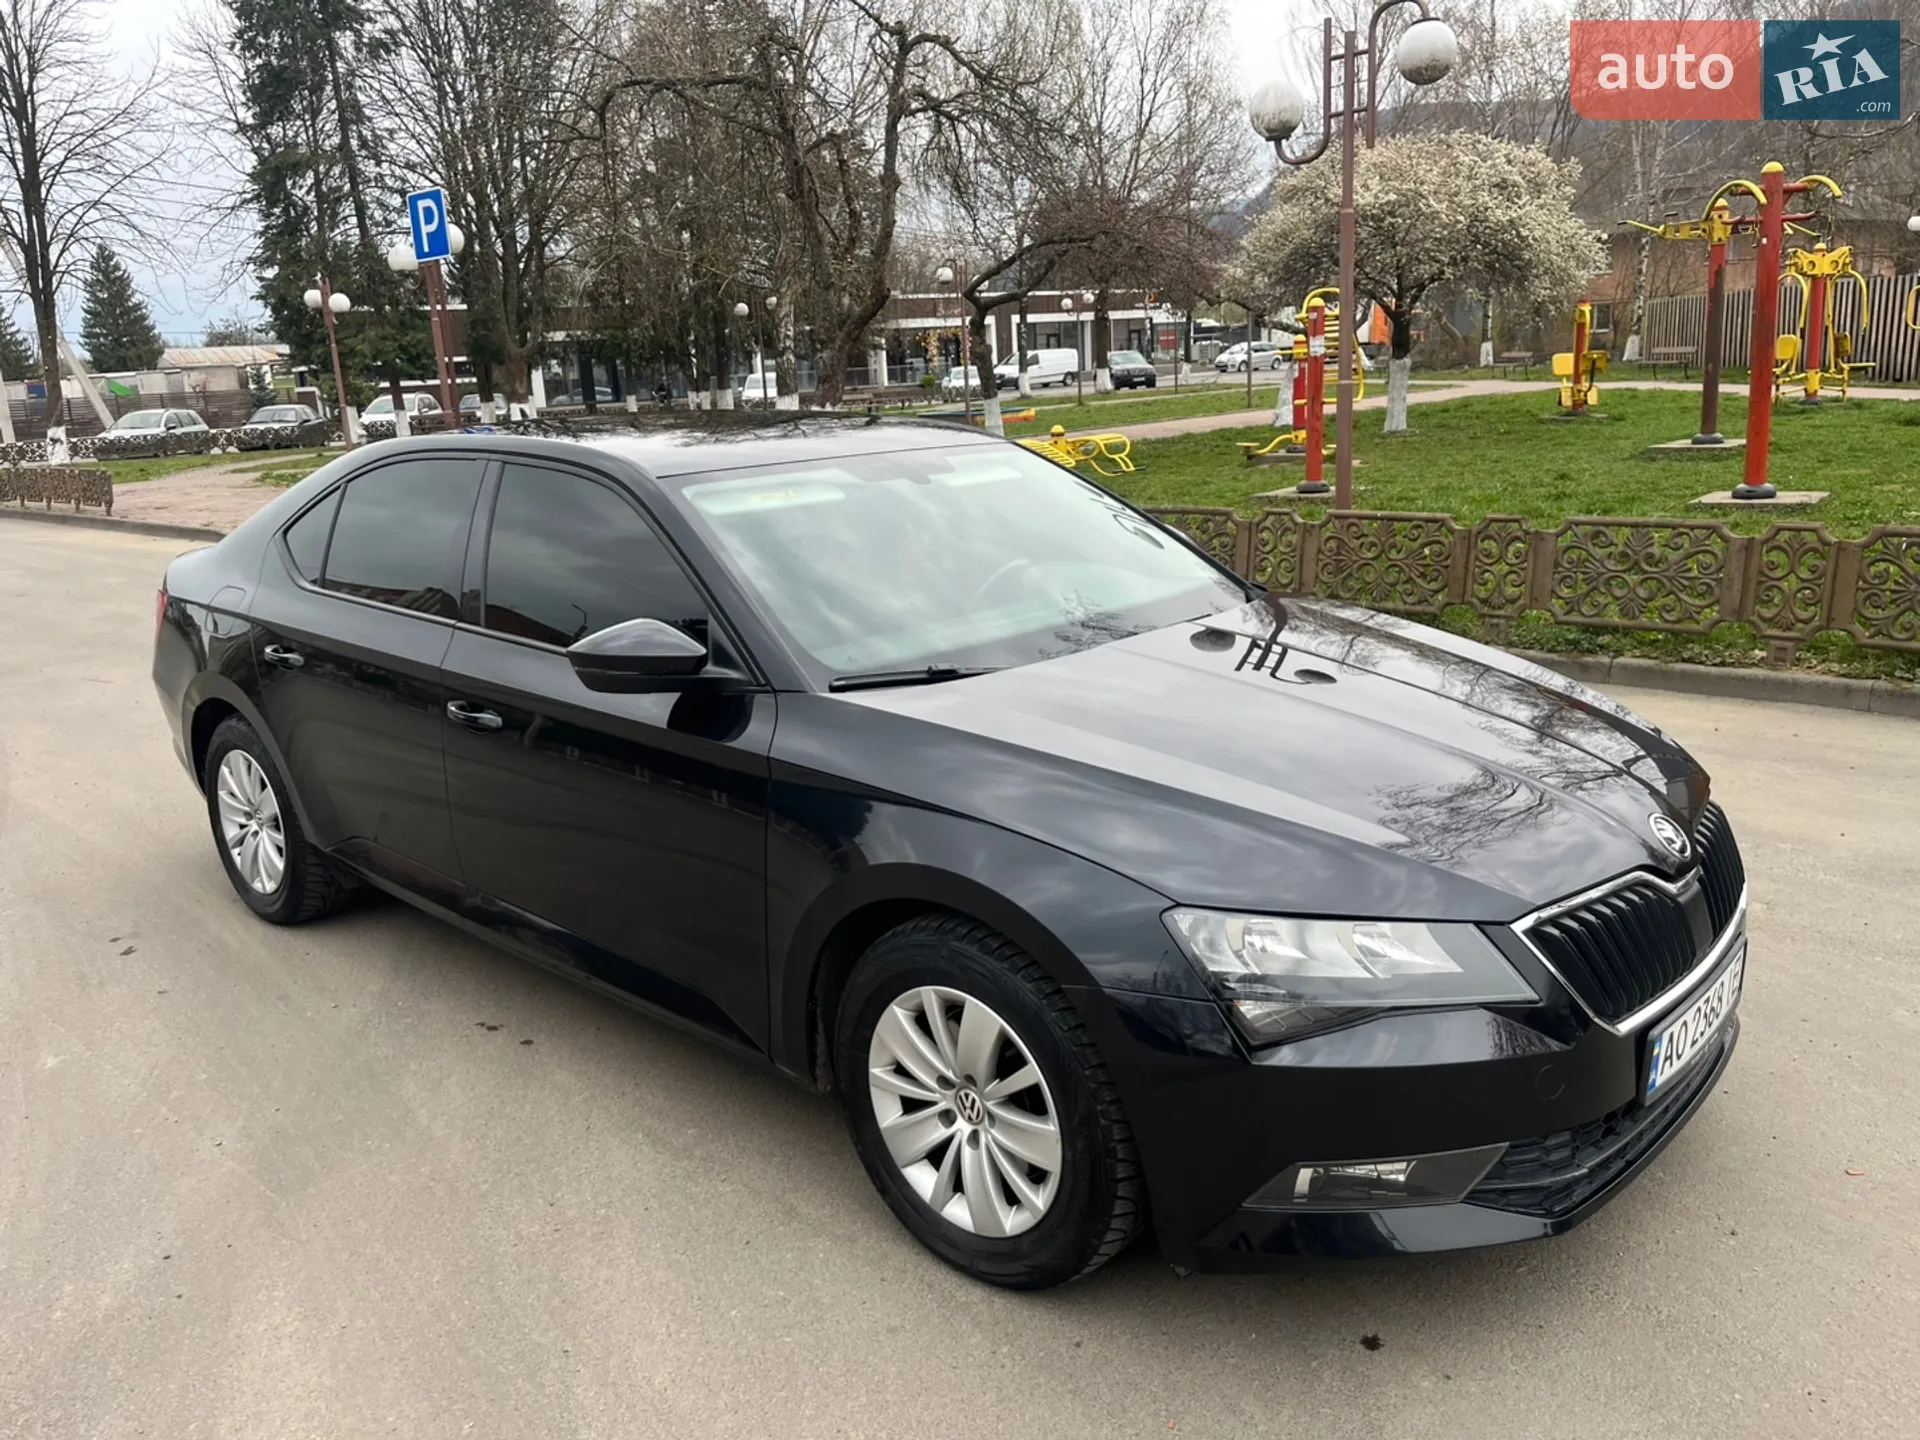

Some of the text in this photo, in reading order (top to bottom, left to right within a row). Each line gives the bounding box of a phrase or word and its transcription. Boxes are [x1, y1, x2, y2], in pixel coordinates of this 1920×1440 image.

[417, 198, 439, 253] P
[1660, 1021, 1688, 1075] AO
[1691, 980, 1724, 1048] 2368
